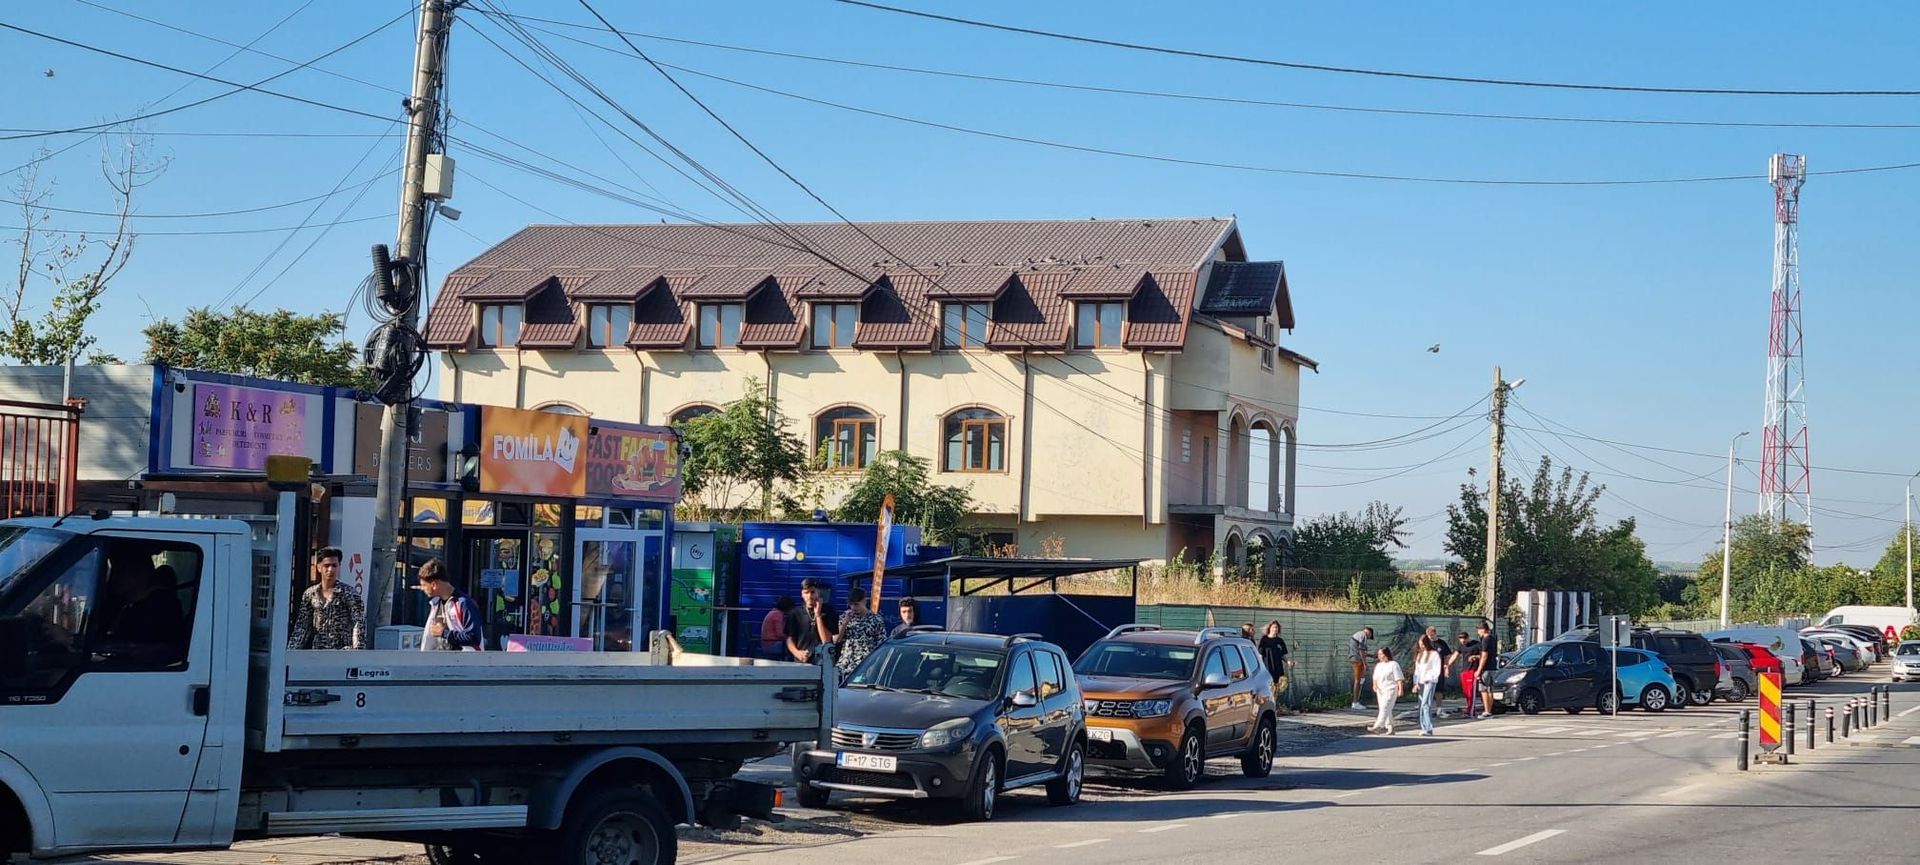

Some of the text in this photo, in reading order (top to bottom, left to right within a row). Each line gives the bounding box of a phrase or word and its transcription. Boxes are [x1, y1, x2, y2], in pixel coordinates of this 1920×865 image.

[231, 401, 272, 424] K & R
[588, 434, 622, 460] FAST
[372, 452, 433, 471] BERS
[359, 669, 390, 678] Legras
[356, 692, 366, 708] 8
[870, 757, 891, 769] STG
